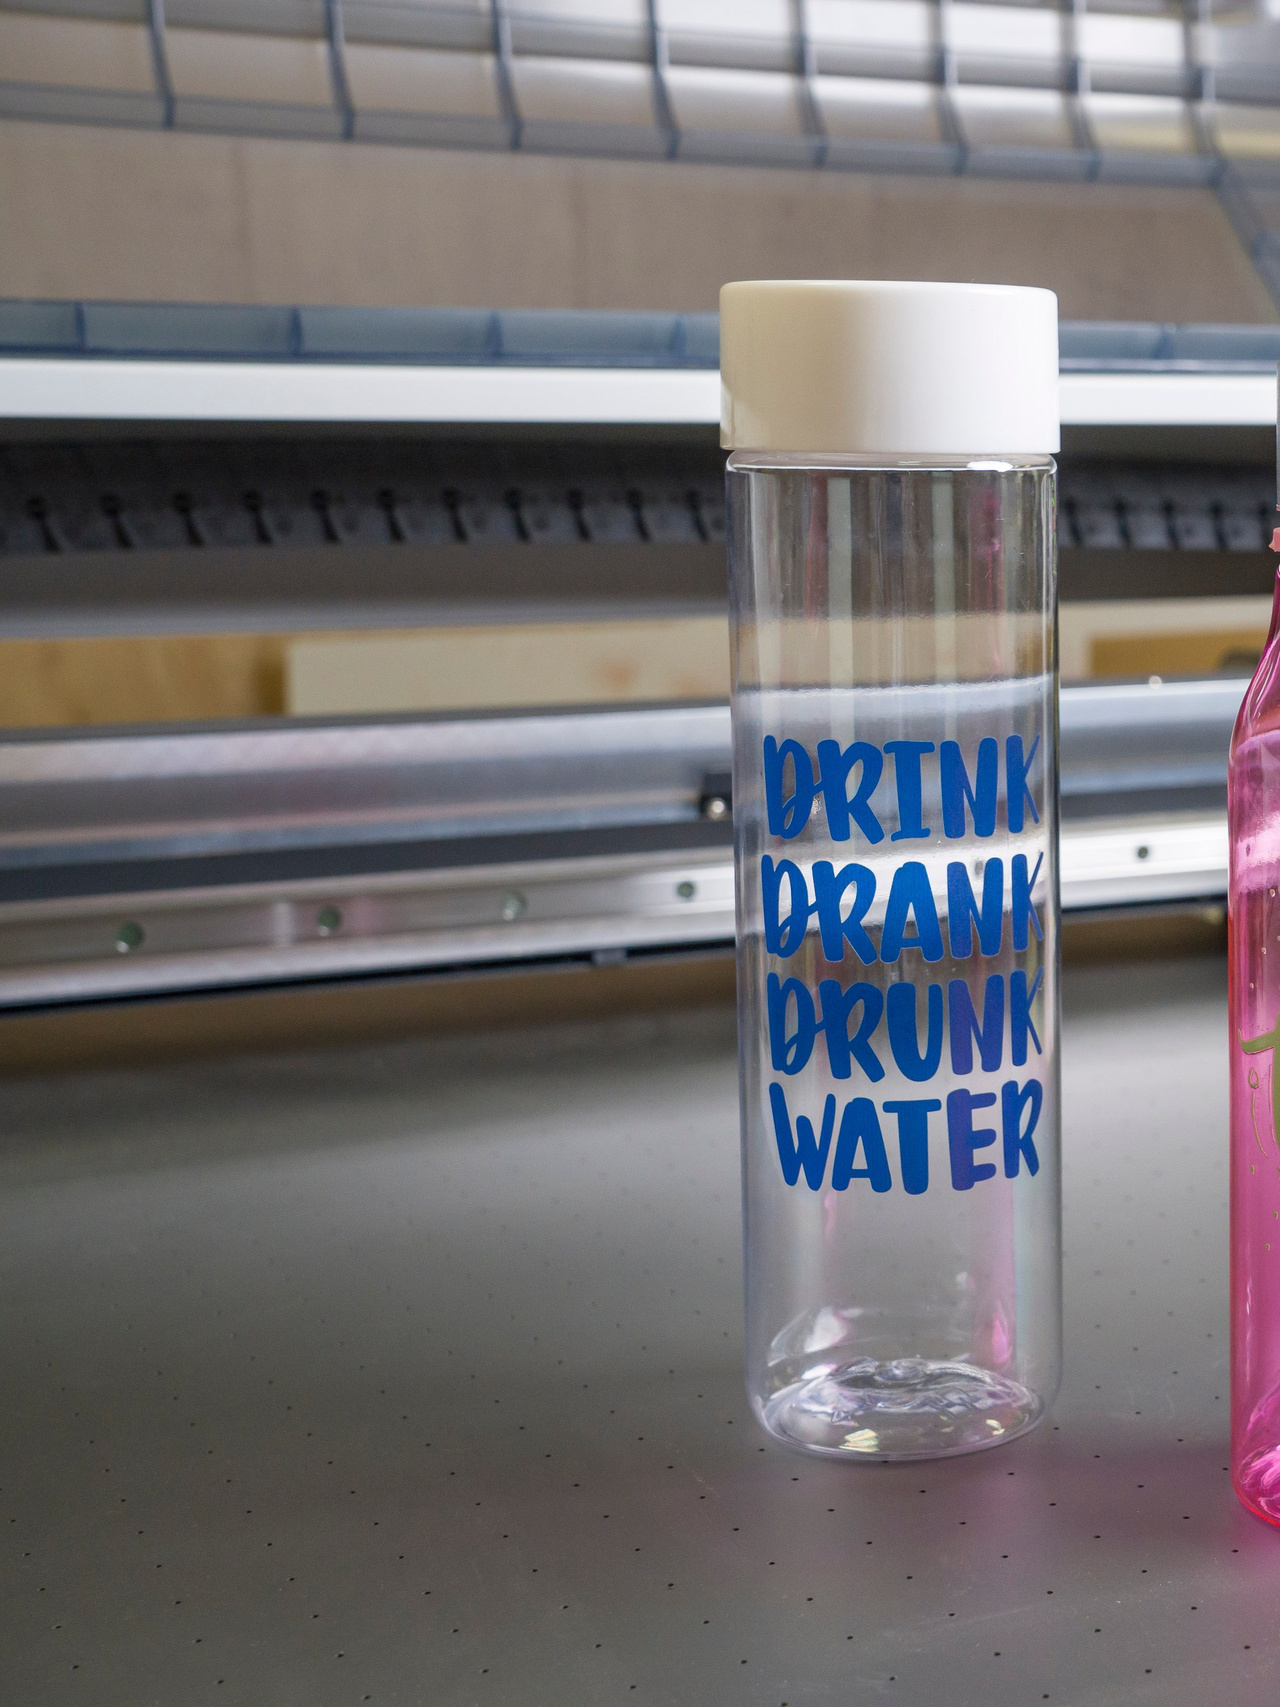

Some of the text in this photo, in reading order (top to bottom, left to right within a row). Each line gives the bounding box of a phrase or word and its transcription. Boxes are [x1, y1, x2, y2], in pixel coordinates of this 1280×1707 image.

[763, 734, 1041, 844] DRINK
[761, 852, 1044, 966] DRANK
[766, 966, 1044, 1083] DRUNK
[769, 1078, 1043, 1195] WATER
